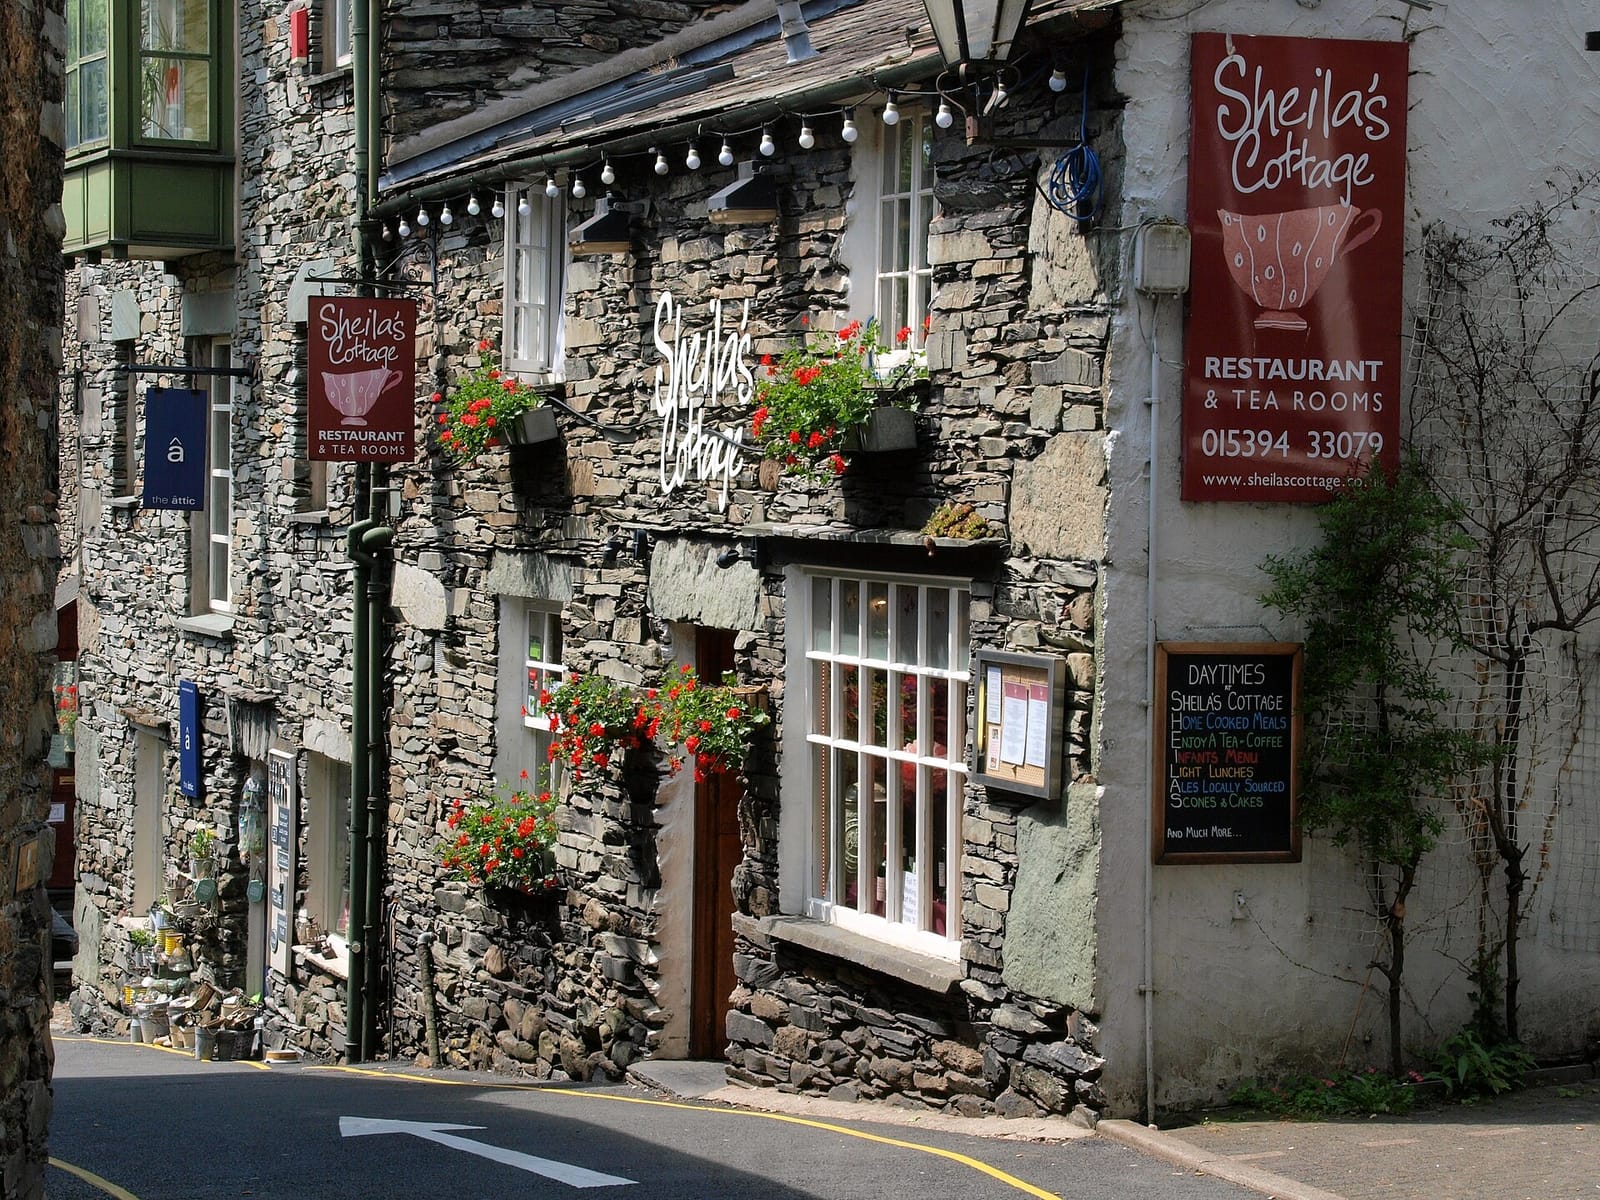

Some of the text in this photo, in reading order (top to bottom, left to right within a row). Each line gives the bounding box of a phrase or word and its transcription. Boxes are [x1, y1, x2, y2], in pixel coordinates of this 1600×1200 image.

[1214, 54, 1390, 141] Sheila's
[1232, 128, 1375, 208] Cottage
[319, 303, 406, 341] Sheila's
[329, 335, 399, 370] Cottage
[654, 291, 754, 417] Sheila's
[1204, 356, 1384, 382] RESTAURANT
[1204, 389, 1383, 413] & TEA ROOMS
[318, 430, 406, 442] RESTAURANT
[1201, 429, 1384, 459] 015394 33079
[318, 444, 406, 455] & TEA ROOMS
[660, 398, 744, 513] Cottage
[1202, 472, 1384, 491] www.sheilascottage.co.
[152, 495, 169, 504] the
[1188, 664, 1266, 685] DAYTIMES
[1171, 690, 1284, 711] SHEILA'S COTTAGE
[1171, 711, 1287, 730] HOME COOKED MEALS
[1171, 730, 1208, 749] ENJOY
[1208, 733, 1217, 748] A
[1174, 749, 1259, 764] INFANTS MENU
[1170, 763, 1255, 779] LIGHT LUNCHES
[1169, 778, 1286, 794] ALES LOCALLY SOURCED
[1170, 793, 1217, 809] SCONES
[1229, 792, 1264, 808] CAKES
[1167, 827, 1183, 838] AND
[1185, 826, 1208, 838] MUCH
